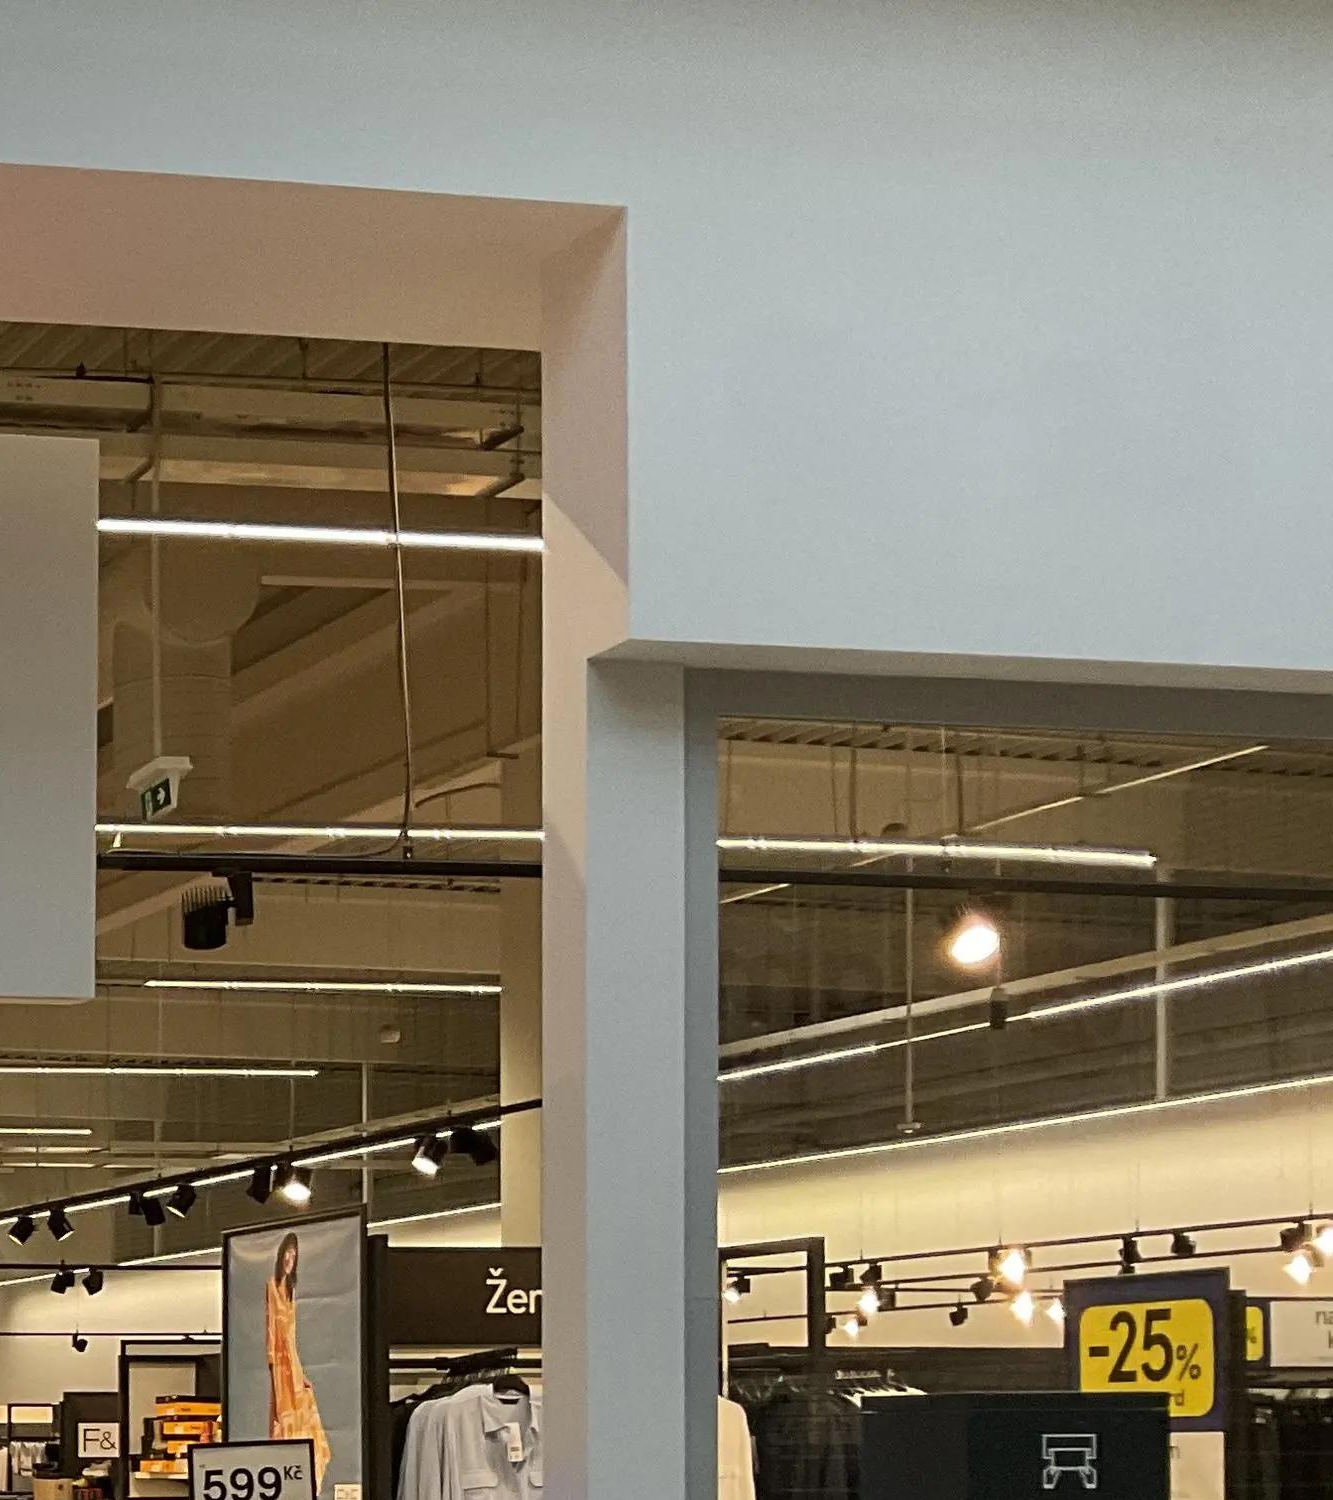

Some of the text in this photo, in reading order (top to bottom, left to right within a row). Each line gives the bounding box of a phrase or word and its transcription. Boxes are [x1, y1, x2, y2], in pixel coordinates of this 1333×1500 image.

[1089, 1307, 1201, 1383] -25%
[82, 1428, 118, 1453] F&
[284, 1465, 303, 1481] Kč
